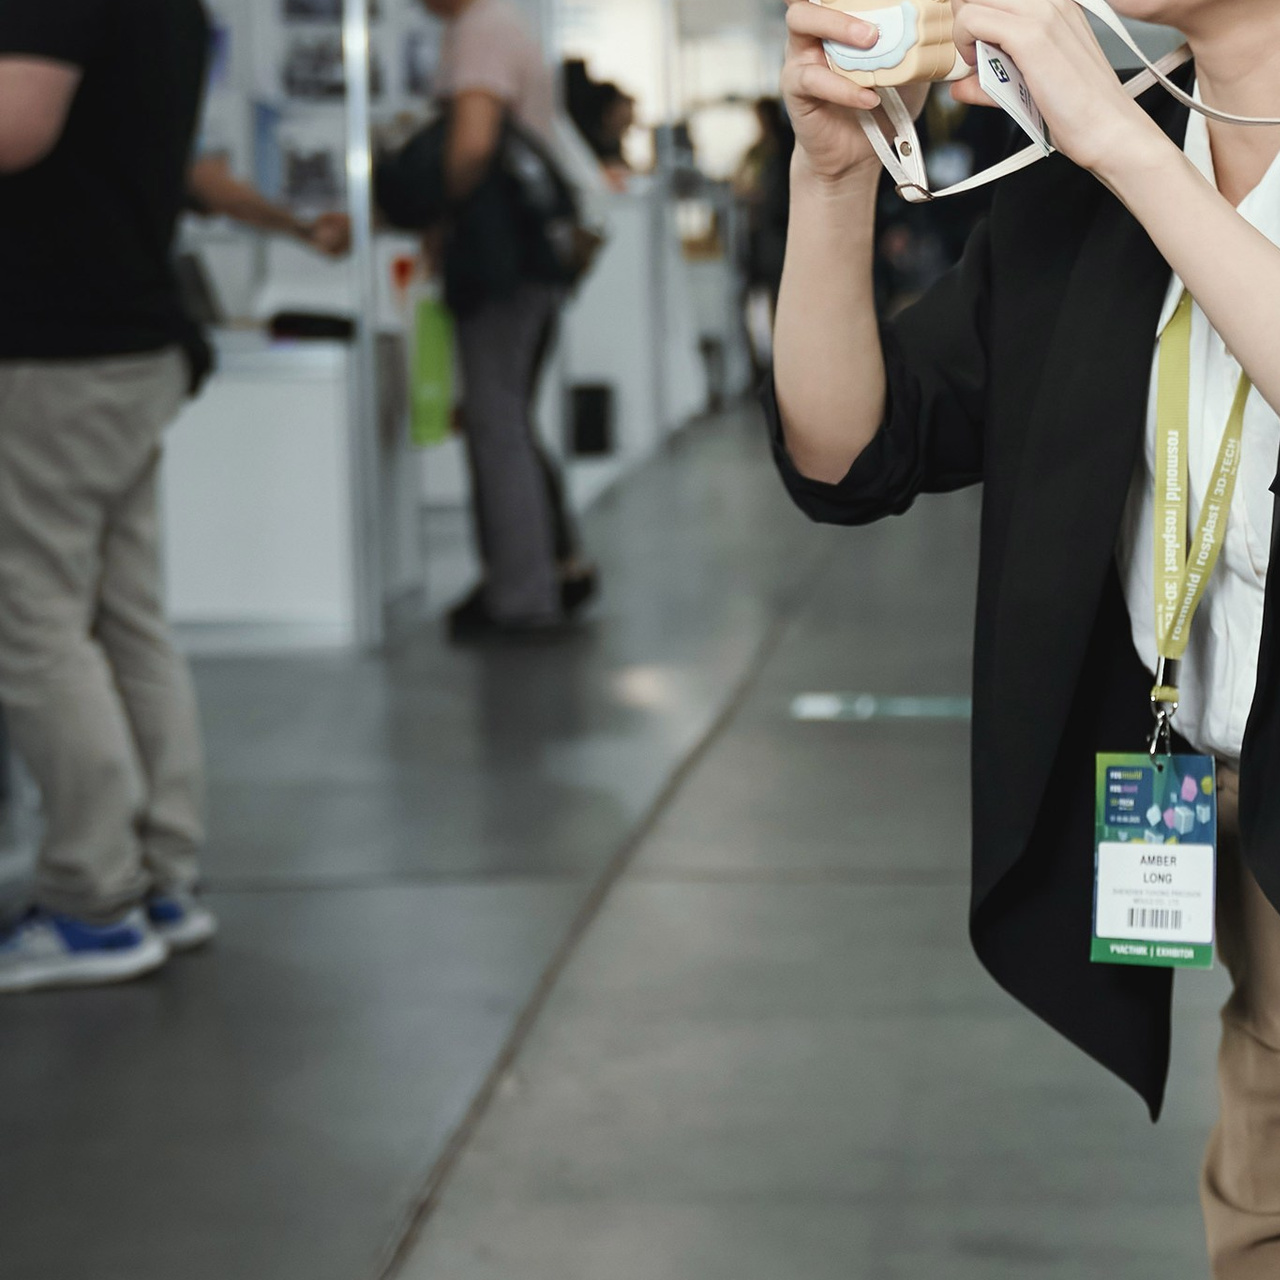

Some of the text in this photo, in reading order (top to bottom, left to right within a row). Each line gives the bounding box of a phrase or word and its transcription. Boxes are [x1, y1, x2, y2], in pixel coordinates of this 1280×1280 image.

[1165, 429, 1181, 501] rosmould
[1162, 509, 1181, 572] rosplast
[1172, 572, 1202, 641] rosmould
[1196, 504, 1220, 566] rosplast
[1213, 438, 1236, 497] 3D-TECH
[1140, 855, 1177, 867] AMBER
[1143, 873, 1173, 885] LONG
